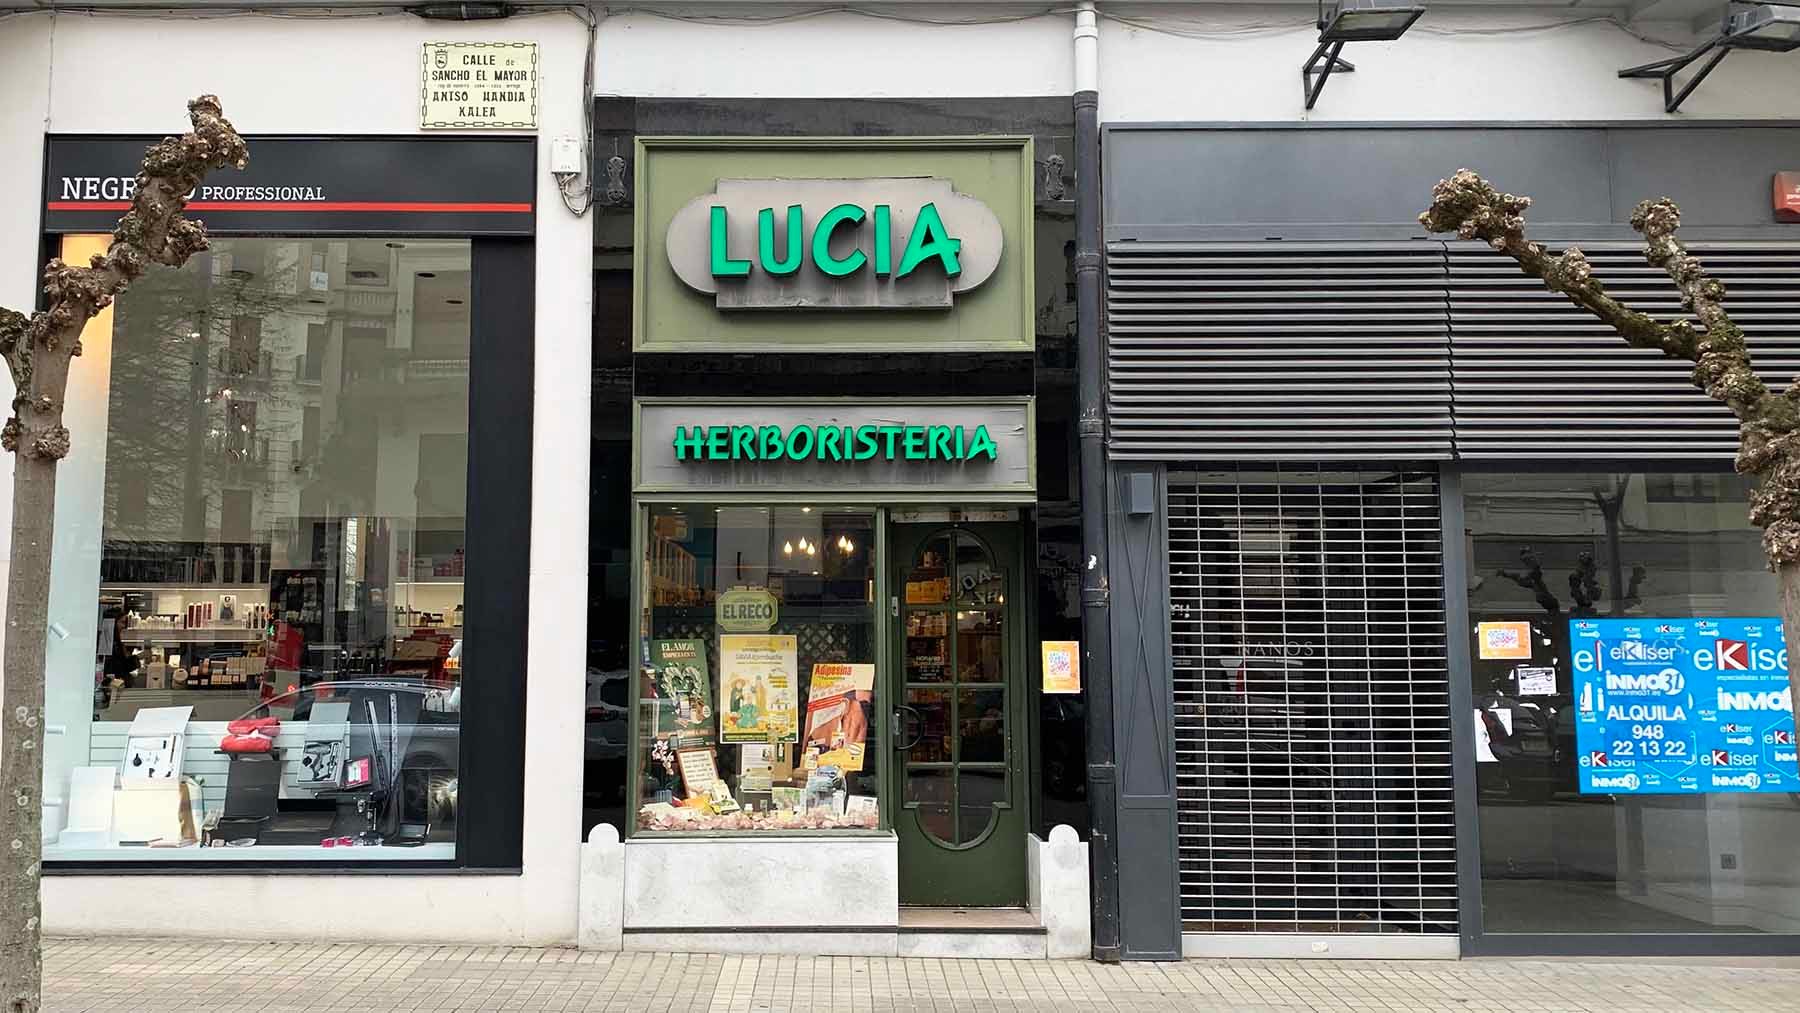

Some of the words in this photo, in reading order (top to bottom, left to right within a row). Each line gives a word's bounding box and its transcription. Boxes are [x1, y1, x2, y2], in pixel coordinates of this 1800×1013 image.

[463, 55, 496, 66] CALLE
[432, 70, 470, 81] SANCHO
[476, 70, 488, 81] EL
[494, 70, 527, 81] MAYOR
[433, 91, 469, 102] ANTSO
[483, 91, 526, 102] HANDIA
[459, 106, 497, 117] KALEA
[201, 186, 326, 201] PROFESSIONAL
[710, 202, 962, 280] LUCIA
[673, 424, 998, 462] HERBORISTERIA
[1606, 705, 1688, 722] ALQUILA
[1632, 725, 1665, 740] 948
[1613, 741, 1634, 756] 22
[1639, 741, 1661, 756] 13
[1664, 741, 1687, 756] 22
